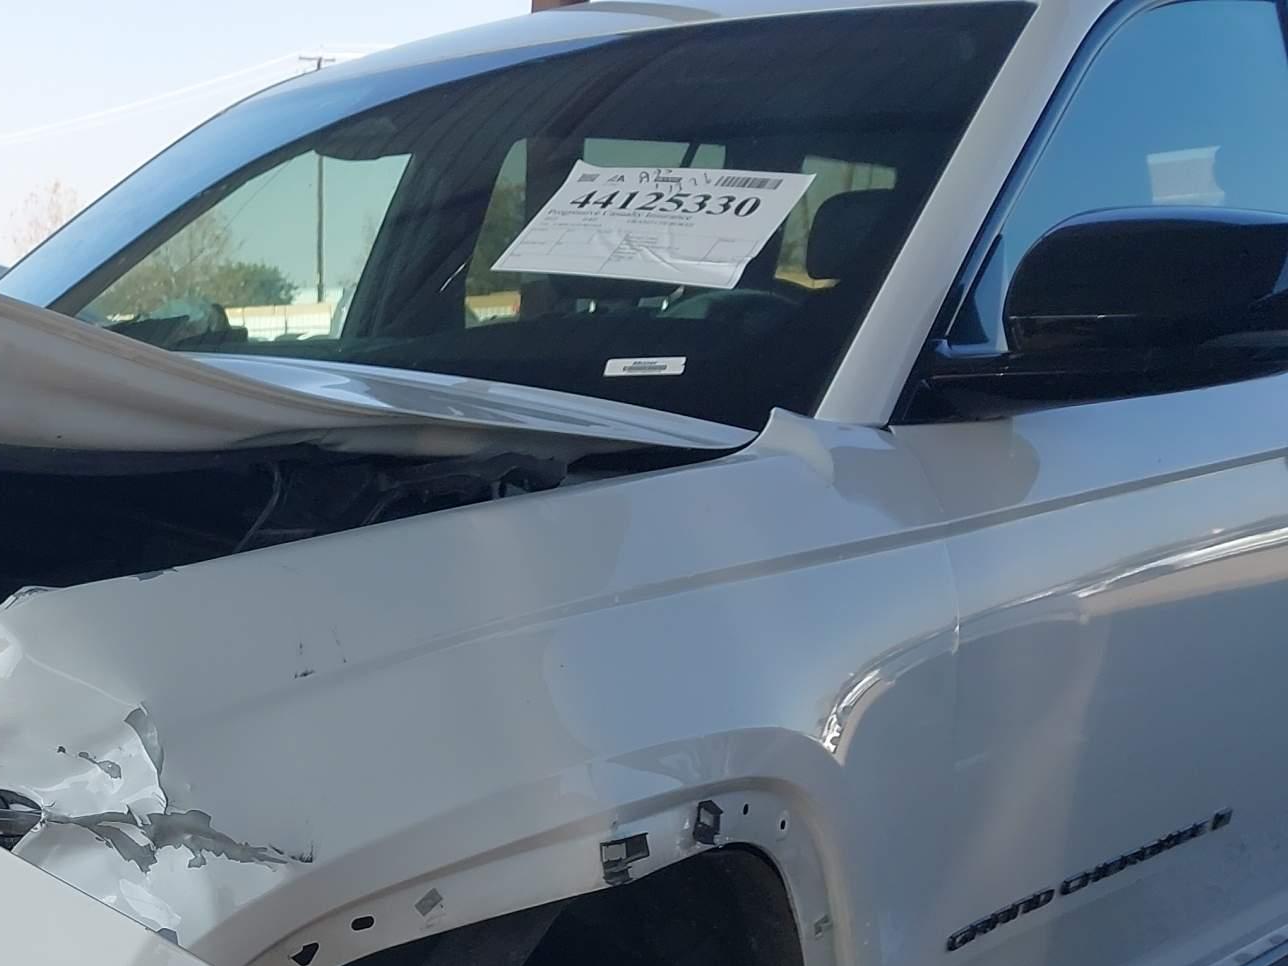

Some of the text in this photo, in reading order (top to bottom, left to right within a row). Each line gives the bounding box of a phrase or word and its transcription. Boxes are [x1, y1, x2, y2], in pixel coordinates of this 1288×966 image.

[570, 190, 761, 217] 44125330
[946, 888, 1055, 951] GRAND
[1060, 819, 1211, 895] CHEROKEE
